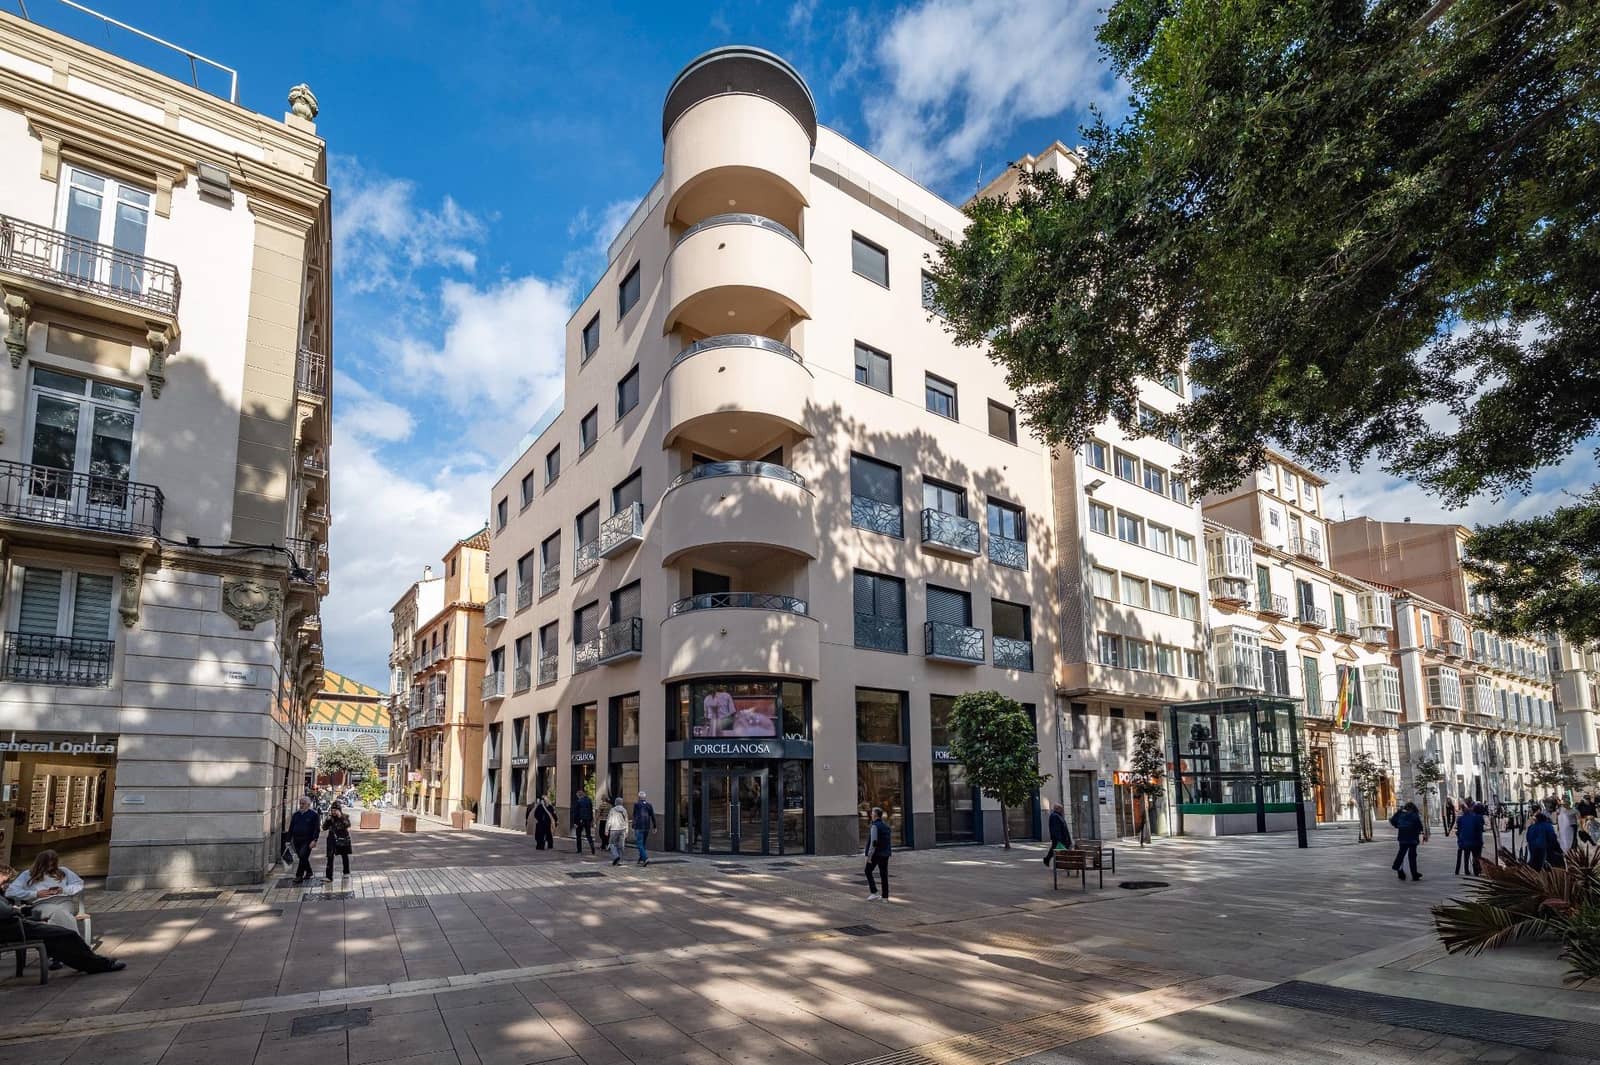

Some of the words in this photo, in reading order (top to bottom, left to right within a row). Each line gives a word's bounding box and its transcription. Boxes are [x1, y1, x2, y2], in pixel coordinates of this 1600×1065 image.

[0, 741, 54, 752] eneral
[60, 741, 115, 755] Optica
[694, 744, 770, 754] PORCELANOSA
